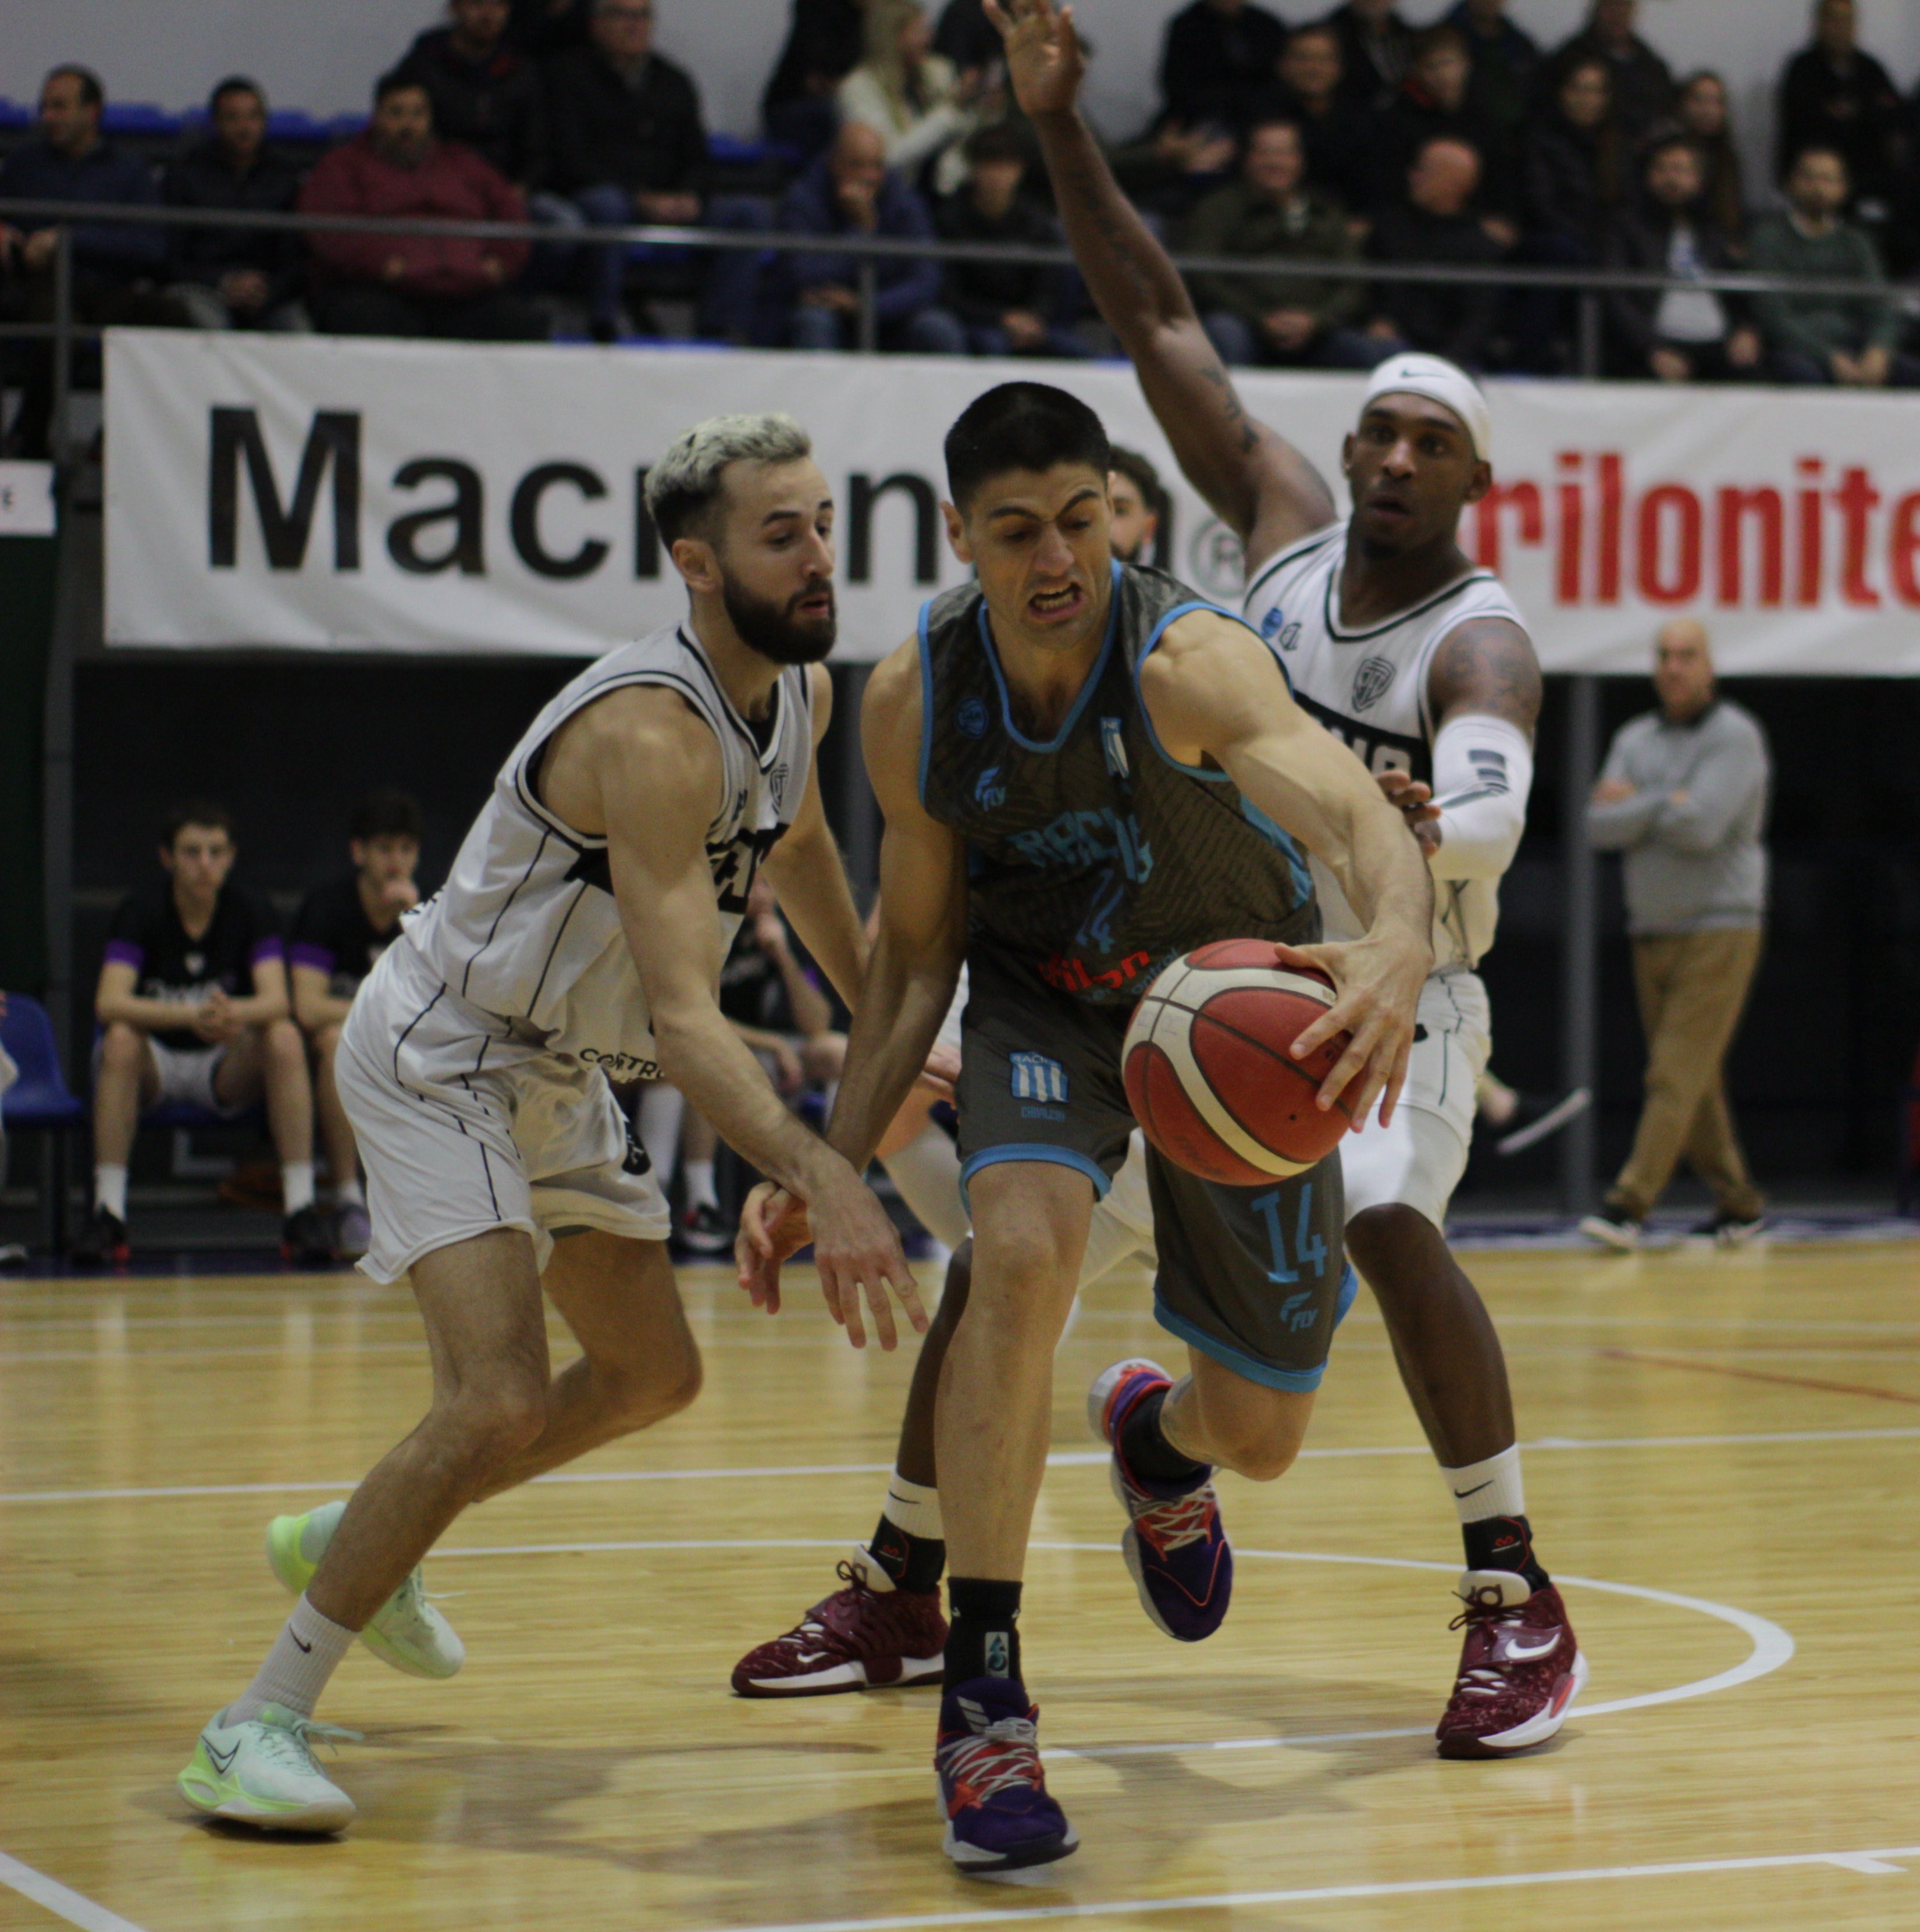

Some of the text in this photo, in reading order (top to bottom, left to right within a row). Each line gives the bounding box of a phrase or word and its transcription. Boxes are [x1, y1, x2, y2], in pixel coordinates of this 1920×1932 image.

[1456, 451, 1920, 610] rilonite
[579, 1048, 662, 1079] COTR
[1251, 1182, 1328, 1283] 14
